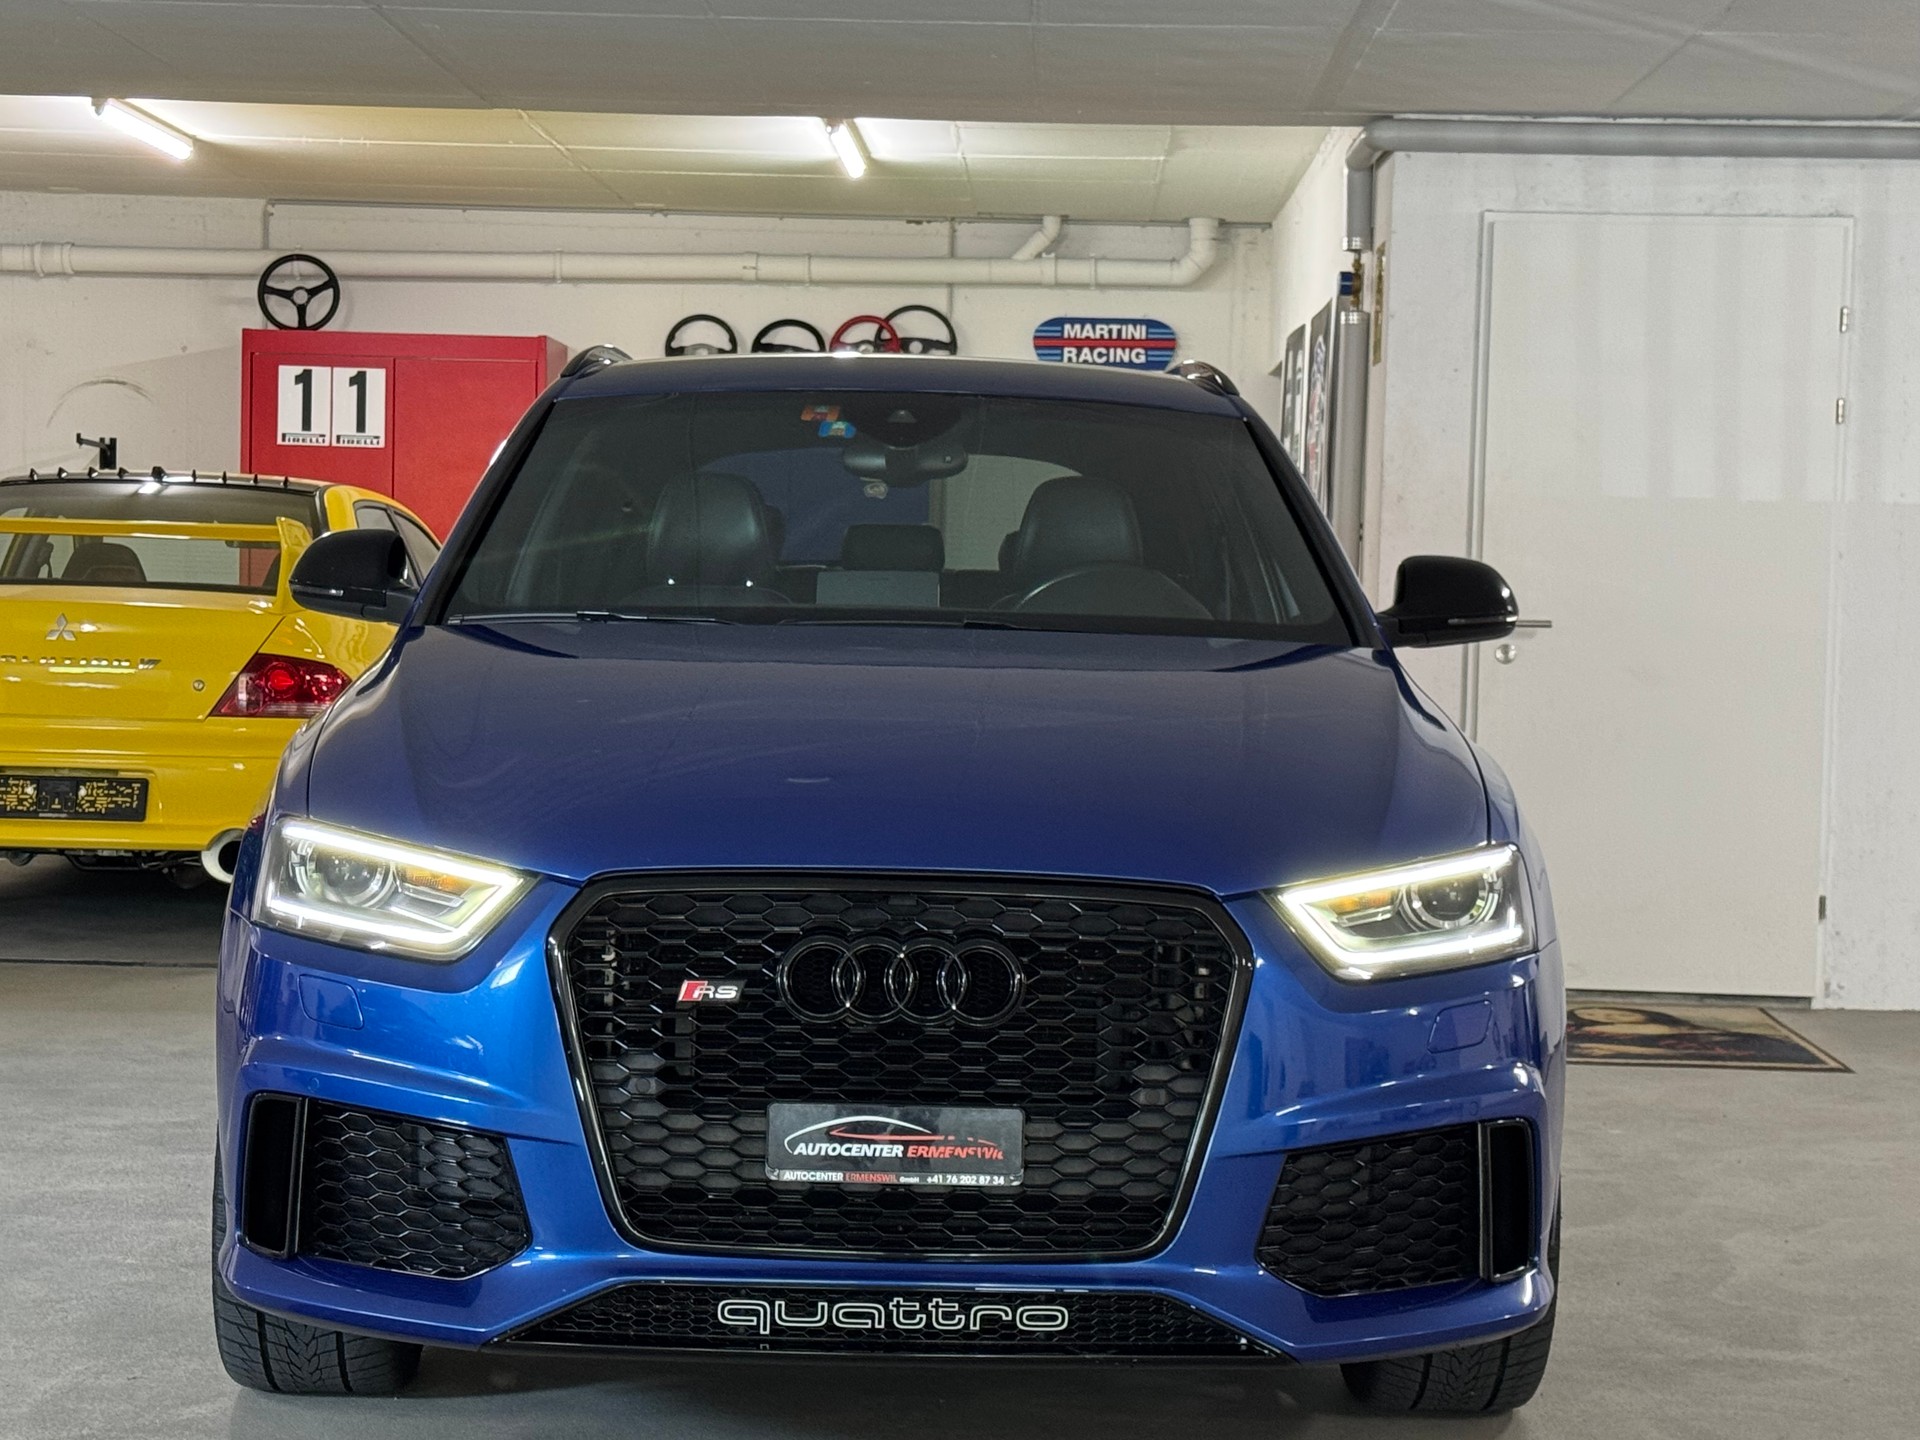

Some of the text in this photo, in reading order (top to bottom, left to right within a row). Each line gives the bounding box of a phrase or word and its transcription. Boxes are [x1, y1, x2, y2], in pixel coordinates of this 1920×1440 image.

[1063, 323, 1147, 340] MARTINI
[1063, 347, 1147, 364] RACING
[690, 984, 739, 999] RS
[793, 1142, 904, 1158] AUTOCENTER
[783, 1170, 844, 1182] AUTOCENTER
[846, 1171, 897, 1184] ERMENSWIL
[926, 1174, 943, 1184] +41
[960, 1175, 977, 1185] 202
[717, 1298, 1069, 1335] quattro
